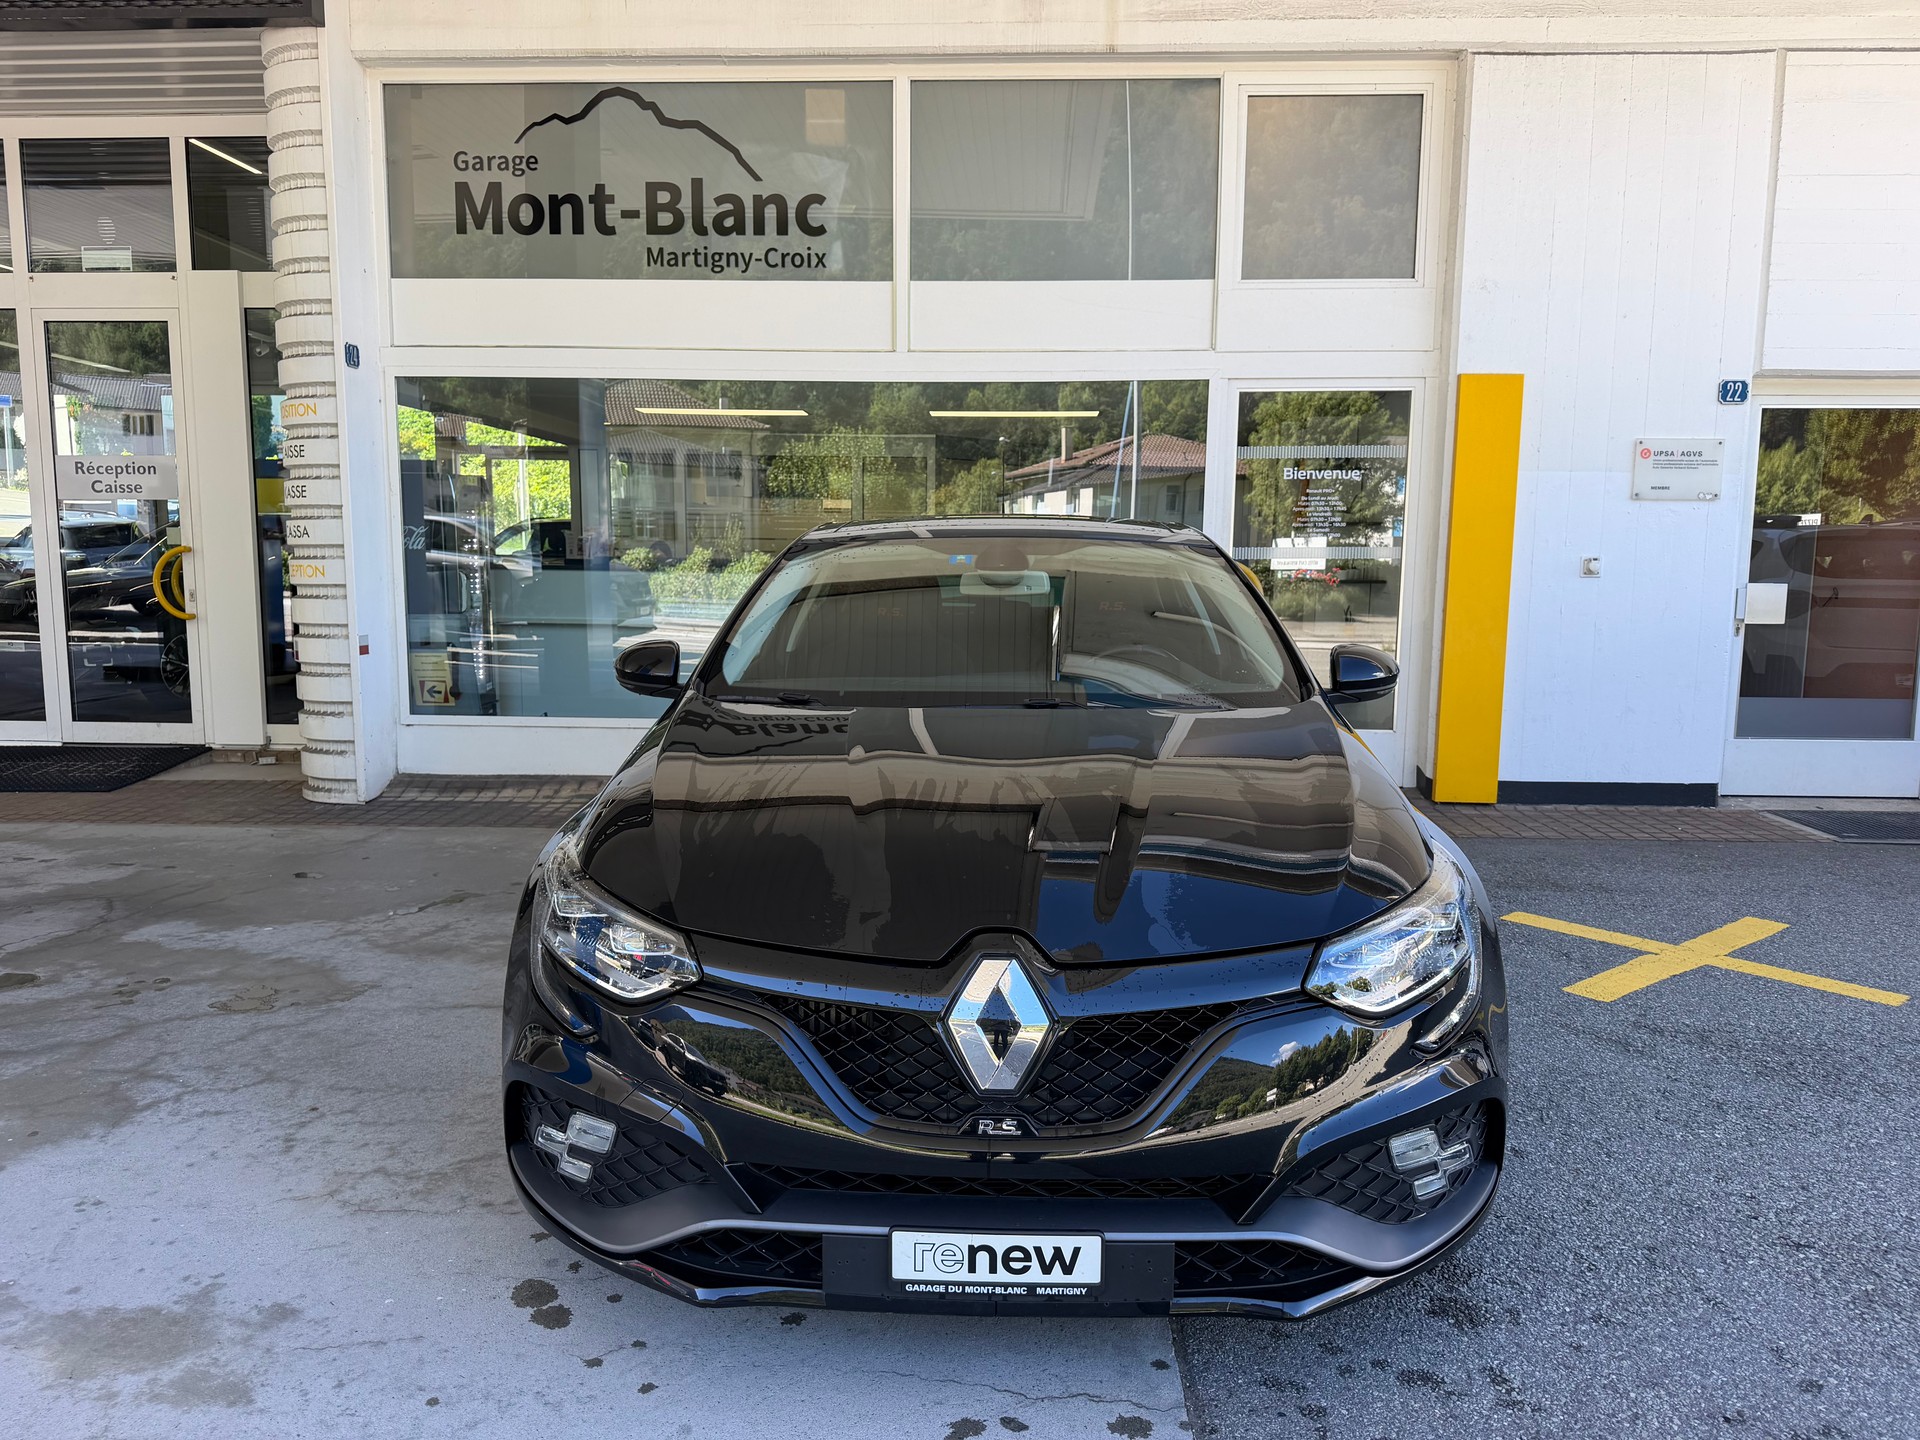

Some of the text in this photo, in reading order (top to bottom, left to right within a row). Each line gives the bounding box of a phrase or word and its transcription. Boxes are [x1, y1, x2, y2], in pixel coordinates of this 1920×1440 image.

[453, 150, 539, 177] Garage
[453, 177, 828, 238] Mont-Blanc
[645, 246, 827, 274] Martigny-Croix
[1726, 382, 1743, 402] 22
[283, 444, 305, 459] AISSE
[74, 461, 157, 479] Réception
[1283, 467, 1361, 480] Bienvenue
[91, 480, 143, 494] Caisse
[287, 524, 310, 539] ASSA
[913, 1242, 1082, 1276] renew
[905, 1283, 1087, 1296] GARAGE DU MONT-BLANC MARTIGNY
